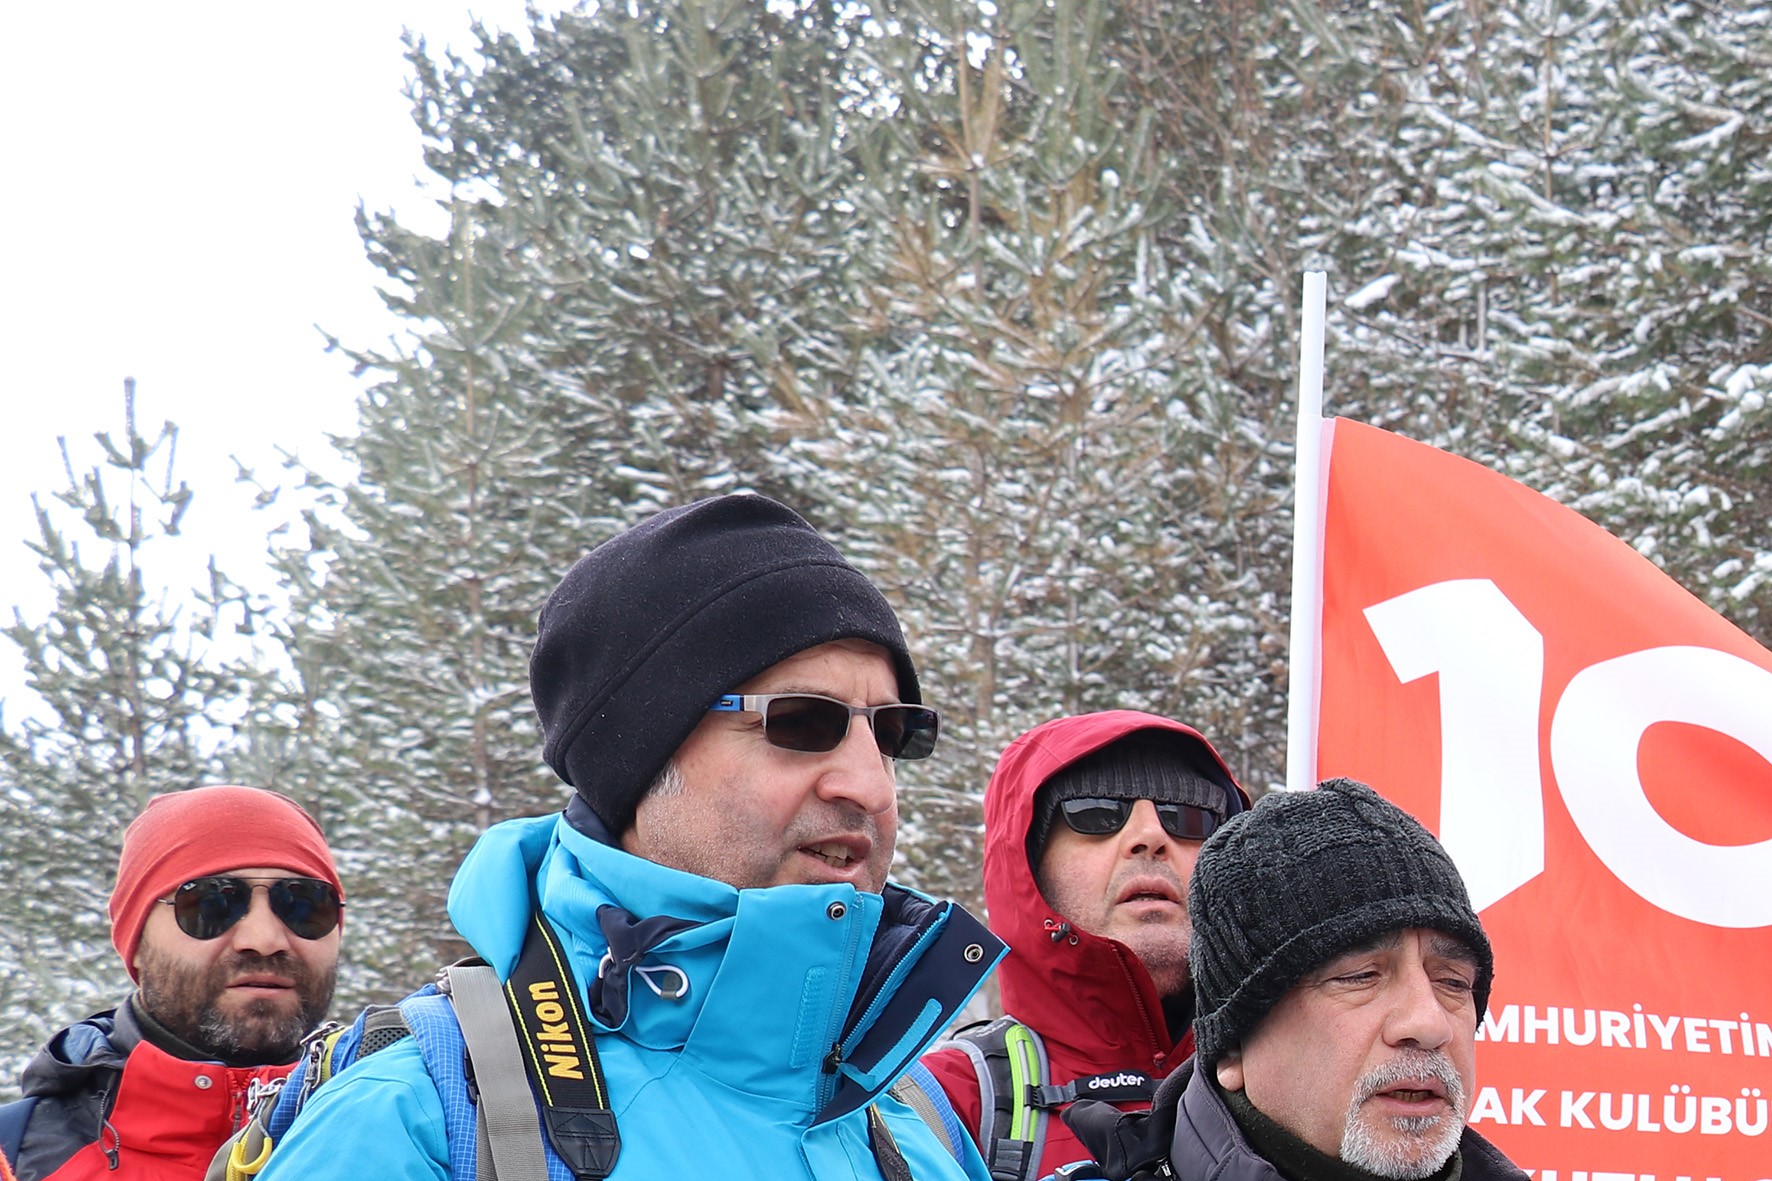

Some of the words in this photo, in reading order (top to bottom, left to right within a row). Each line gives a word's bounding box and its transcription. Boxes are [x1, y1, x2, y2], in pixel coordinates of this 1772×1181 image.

[528, 980, 584, 1081] Nikon
[1088, 1073, 1146, 1091] deuter
[1467, 1086, 1548, 1126] AK
